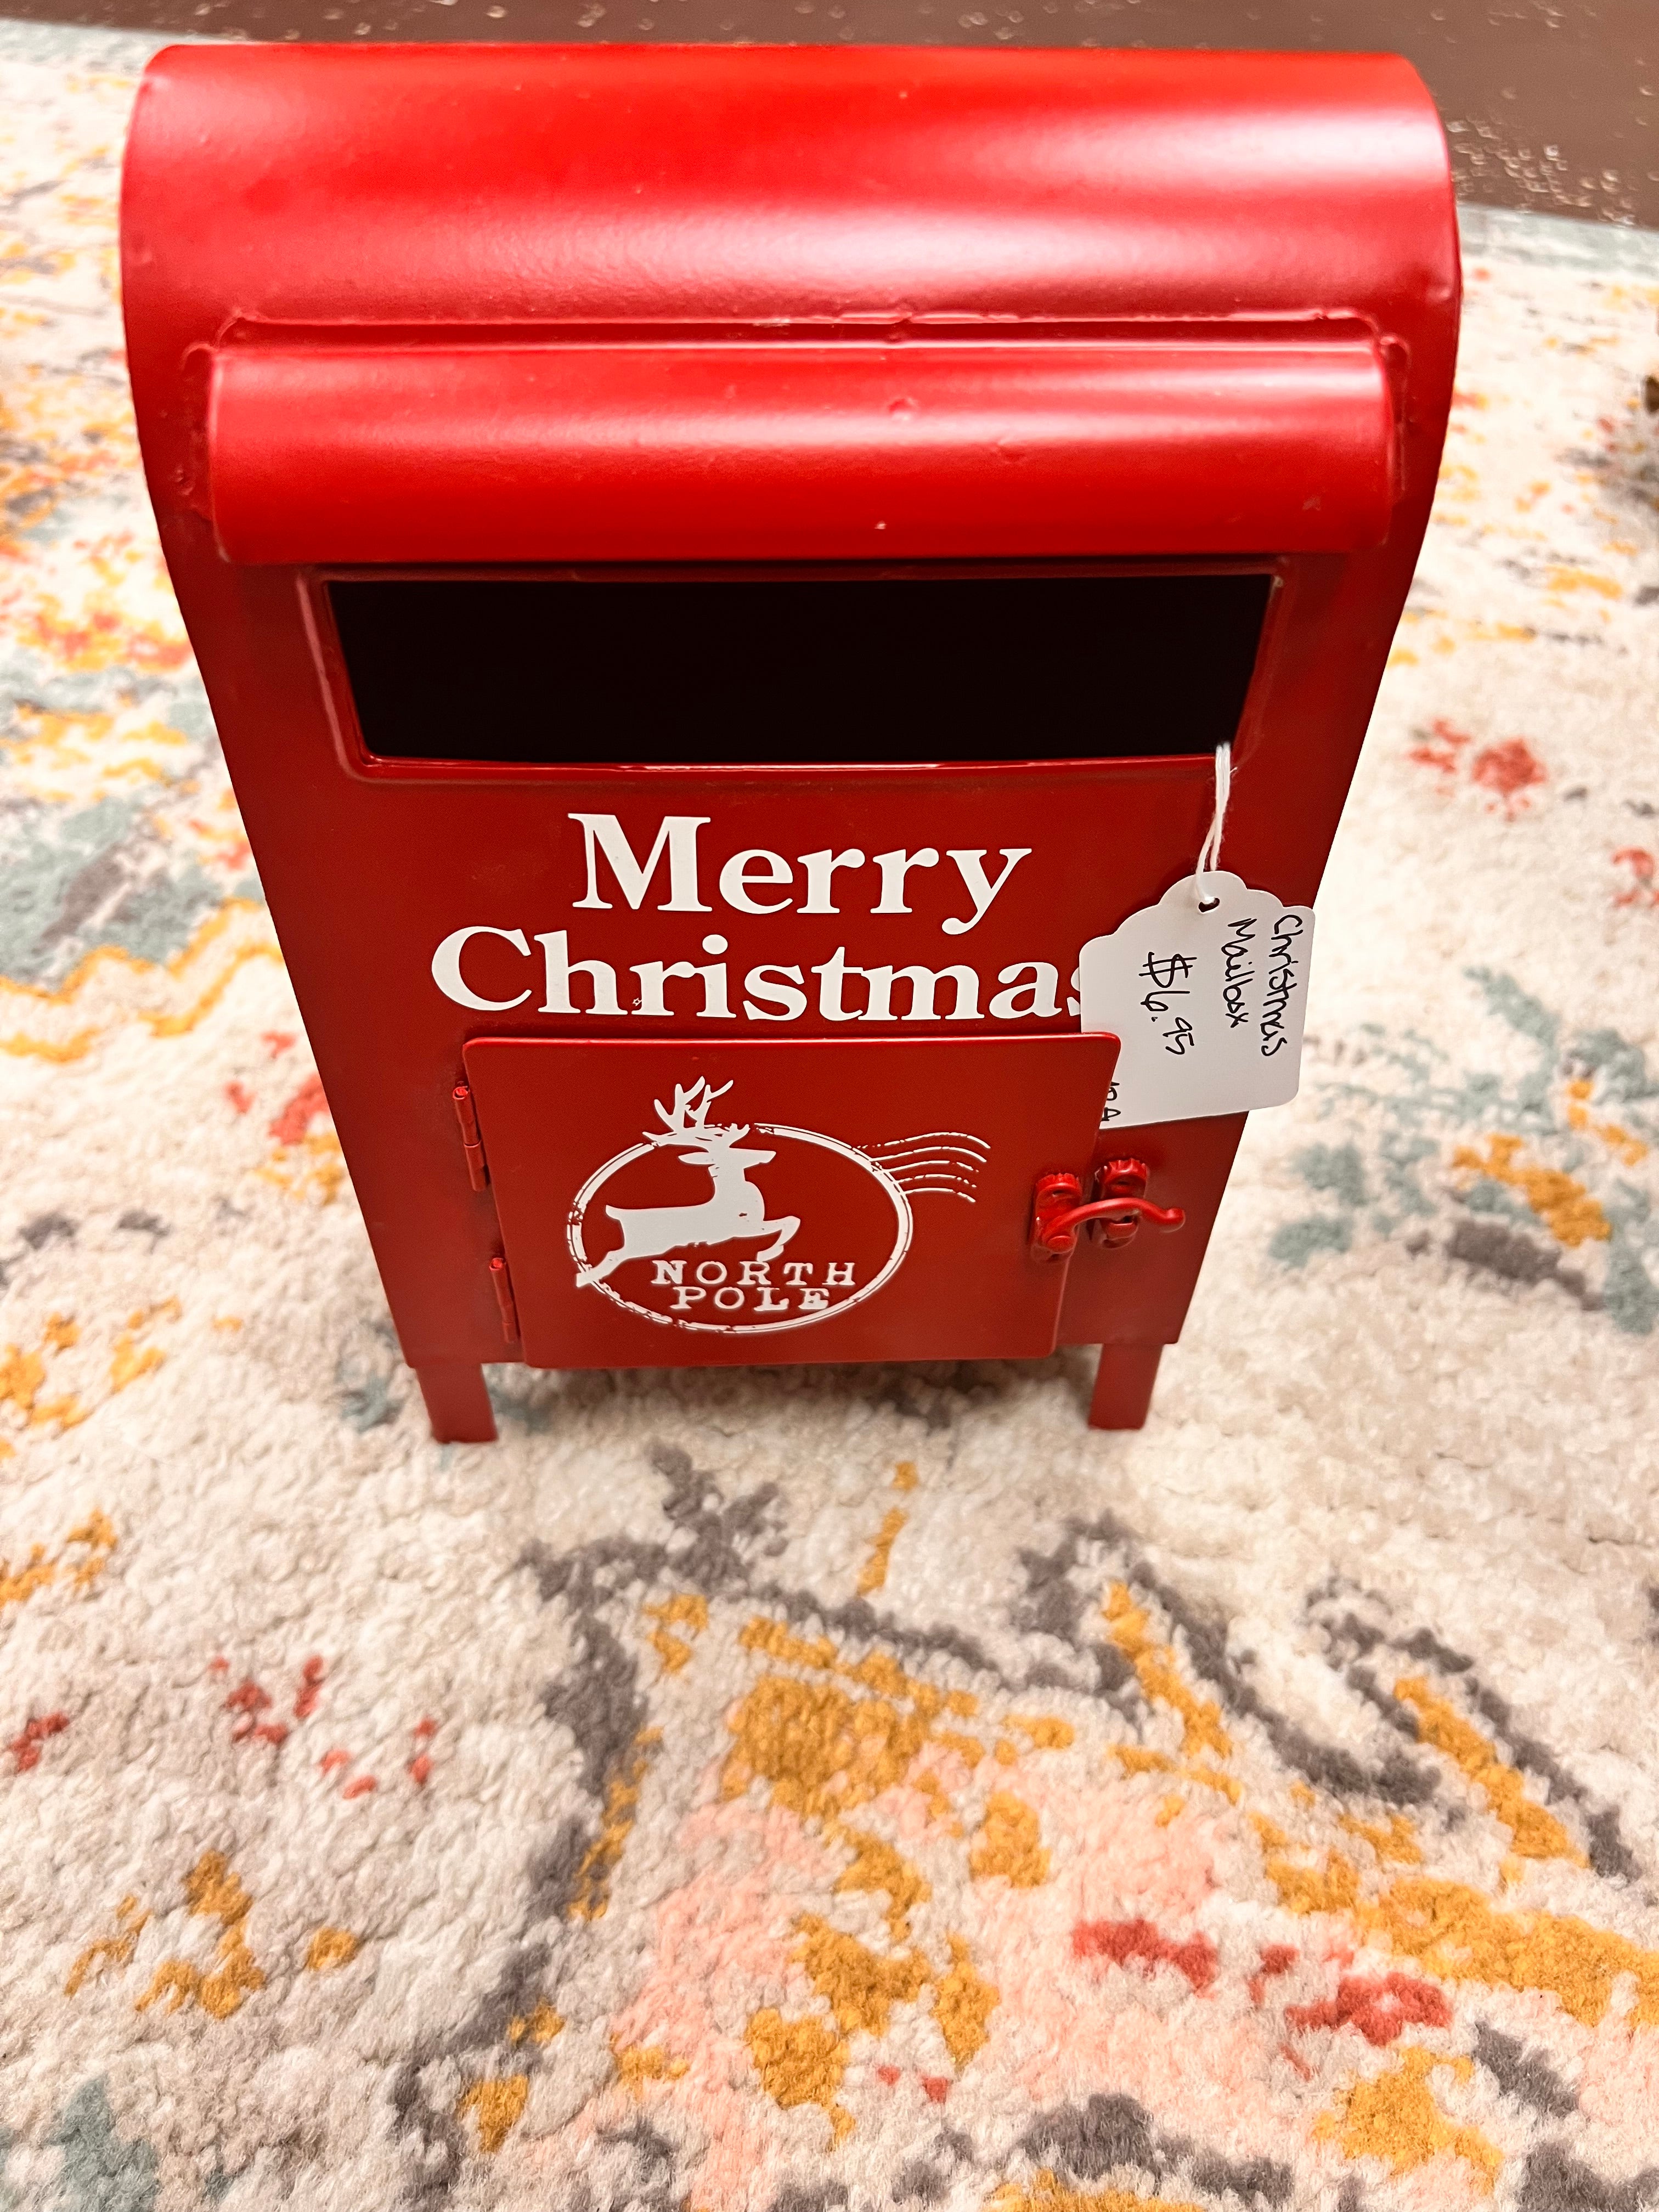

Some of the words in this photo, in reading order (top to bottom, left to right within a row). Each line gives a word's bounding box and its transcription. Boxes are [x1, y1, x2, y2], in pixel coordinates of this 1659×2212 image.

[568, 812, 1032, 935] Merry
[431, 926, 1081, 1021] Christma
[1138, 951, 1197, 1054] $6.95
[1221, 918, 1257, 1028] Mailbox
[1260, 914, 1304, 1057] Christmas
[651, 1260, 856, 1285] NORTH
[669, 1286, 830, 1311] POLE
